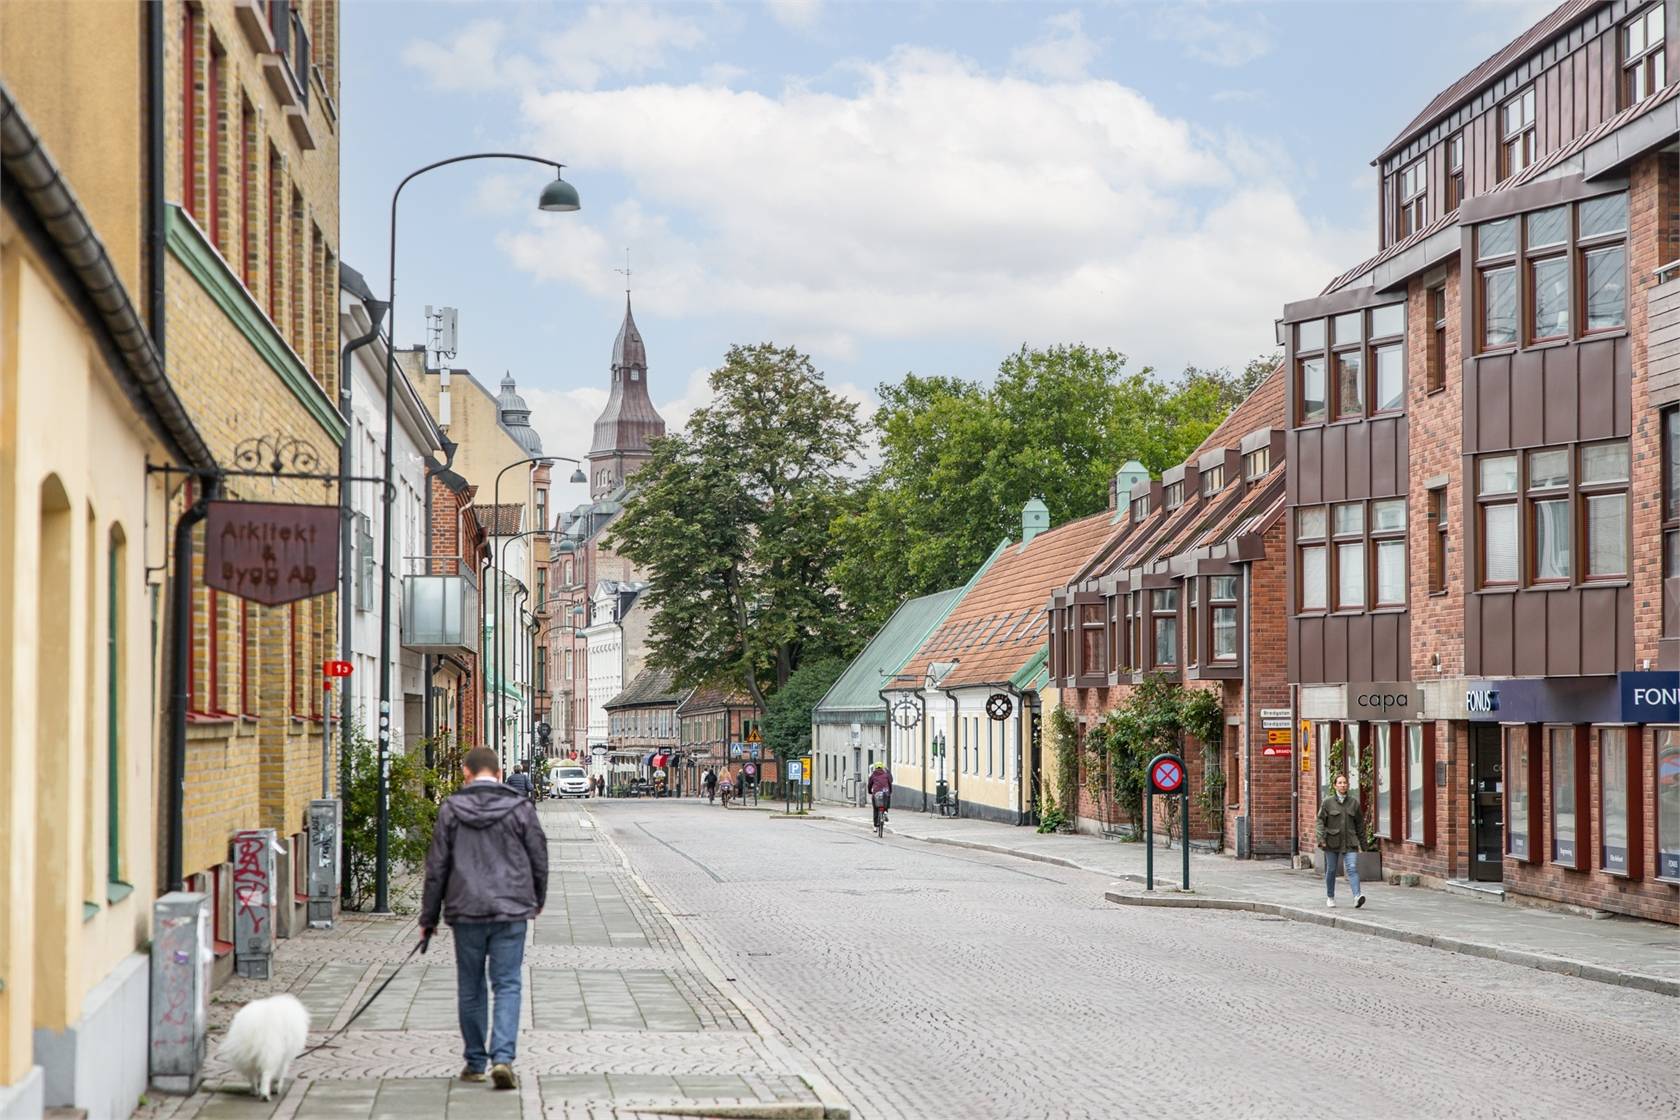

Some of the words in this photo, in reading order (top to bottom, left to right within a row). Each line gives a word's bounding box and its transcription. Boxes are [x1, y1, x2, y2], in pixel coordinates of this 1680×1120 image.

[221, 521, 317, 544] Arkitekt
[262, 544, 277, 562] &
[222, 561, 279, 586] Bygg
[287, 565, 317, 584] AB
[1358, 694, 1408, 712] capa
[1466, 690, 1491, 712] FONUS
[1634, 688, 1680, 705] FON
[792, 763, 798, 773] P
